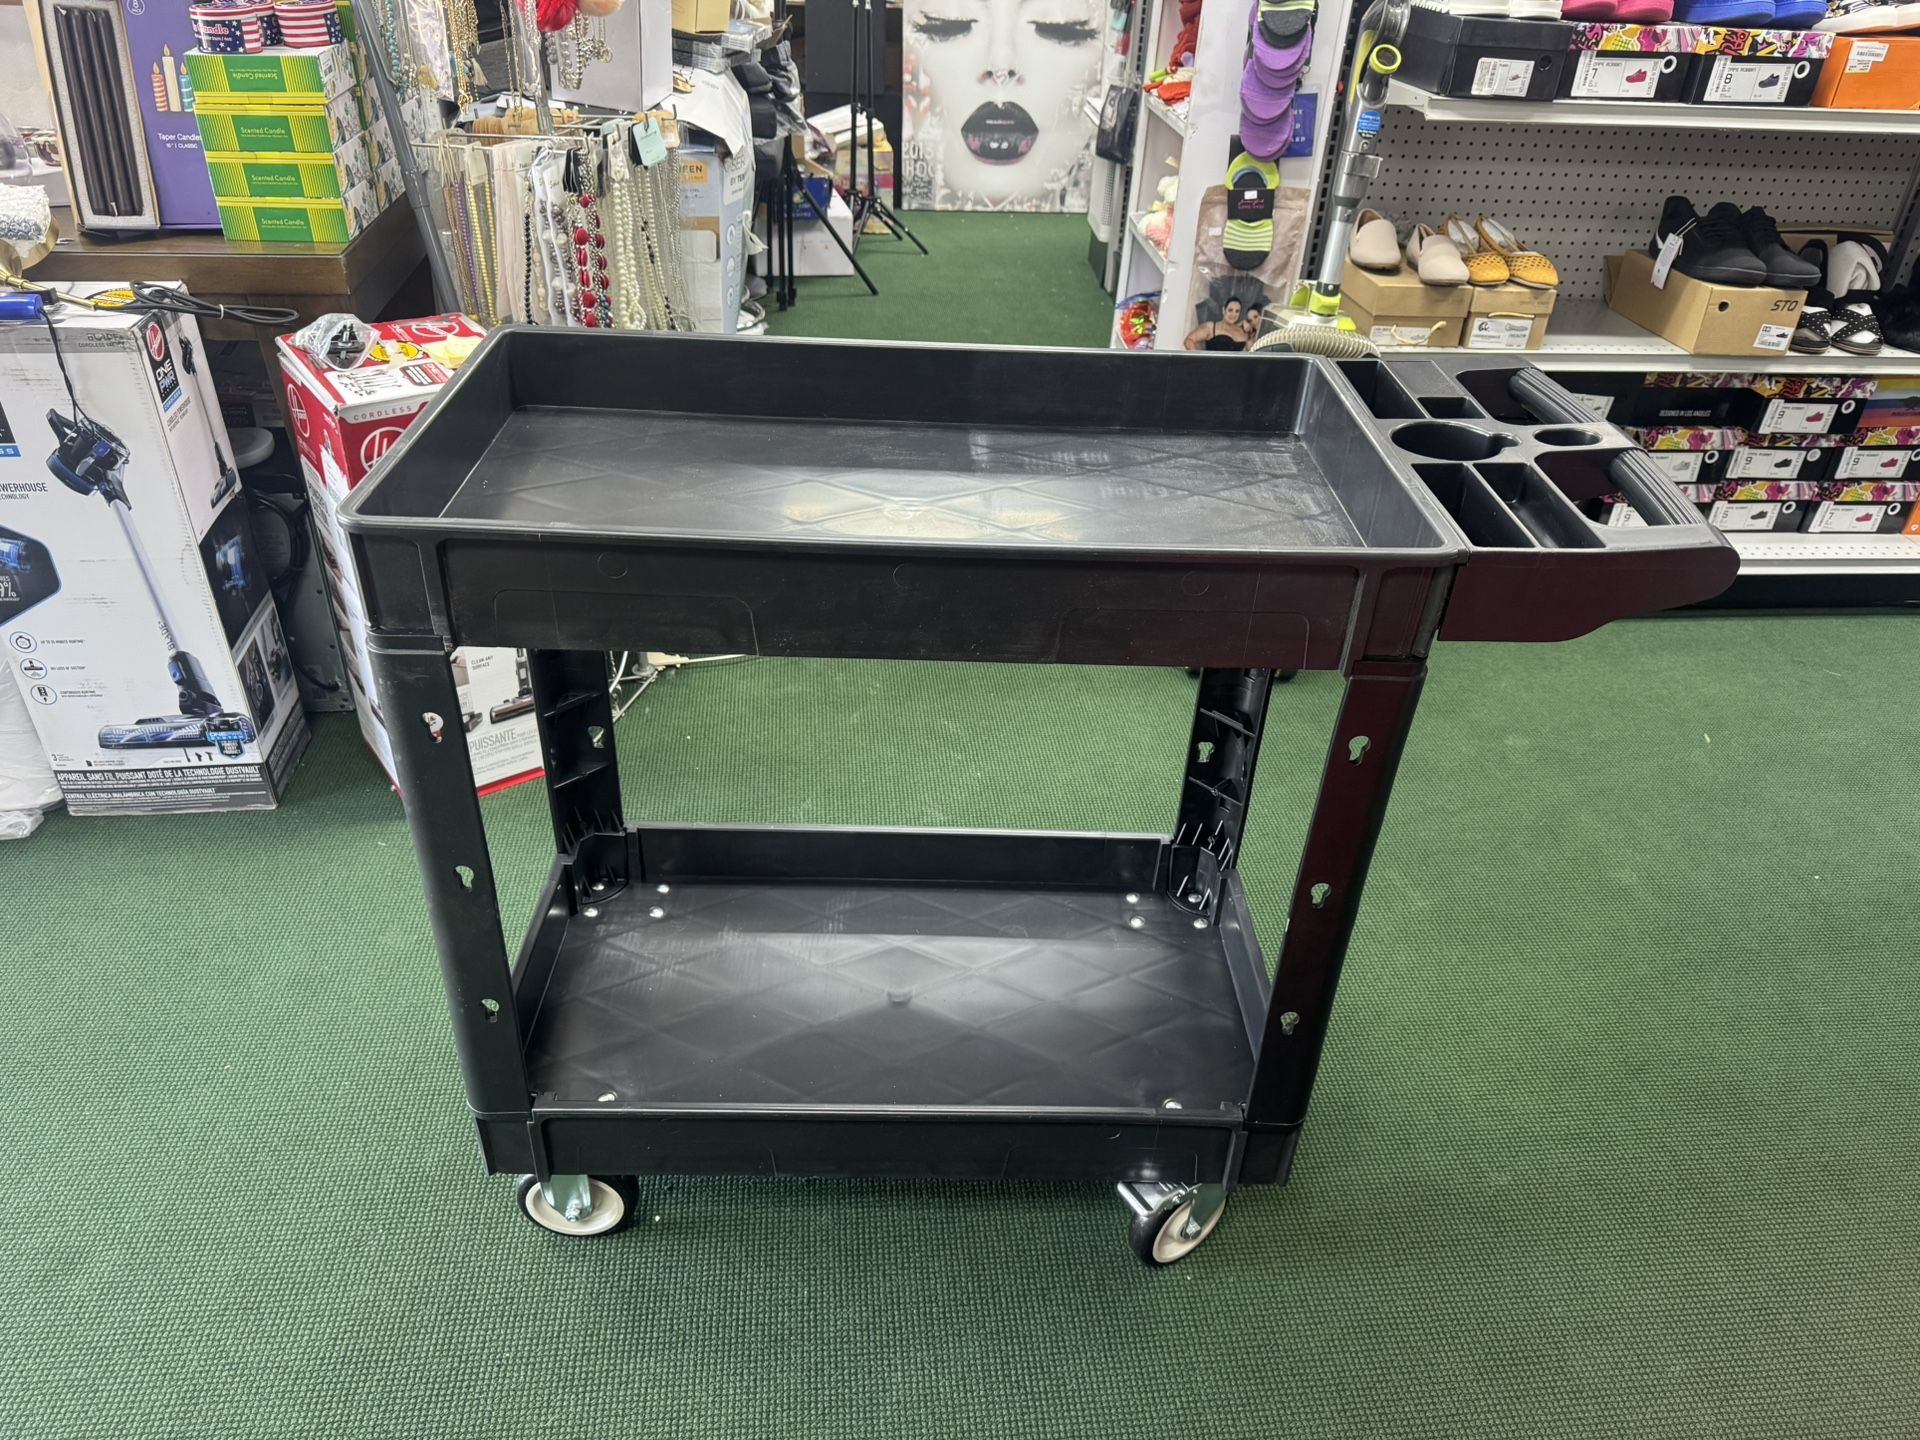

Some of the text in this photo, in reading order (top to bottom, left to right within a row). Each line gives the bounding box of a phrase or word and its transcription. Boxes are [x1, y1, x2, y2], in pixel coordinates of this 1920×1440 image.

[232, 72, 254, 80] Candle
[1592, 68, 1598, 79] 7
[1724, 73, 1732, 85] 8
[158, 133, 176, 142] Taper
[251, 174, 274, 182] Scented
[261, 218, 284, 226] Scented
[156, 359, 173, 381] ONE
[159, 371, 177, 393] PWR
[353, 405, 413, 421] CORDLESS
[469, 728, 517, 753] PUISSANTE
[57, 772, 87, 781] APPAREIL
[87, 772, 105, 781] SANS
[104, 771, 116, 780] FIL
[115, 771, 147, 780] PUISSANT
[146, 768, 164, 779] DOTÉ
[164, 770, 174, 778] DE
[173, 769, 183, 778] LA
[183, 767, 226, 777] TECHNOLOGIE
